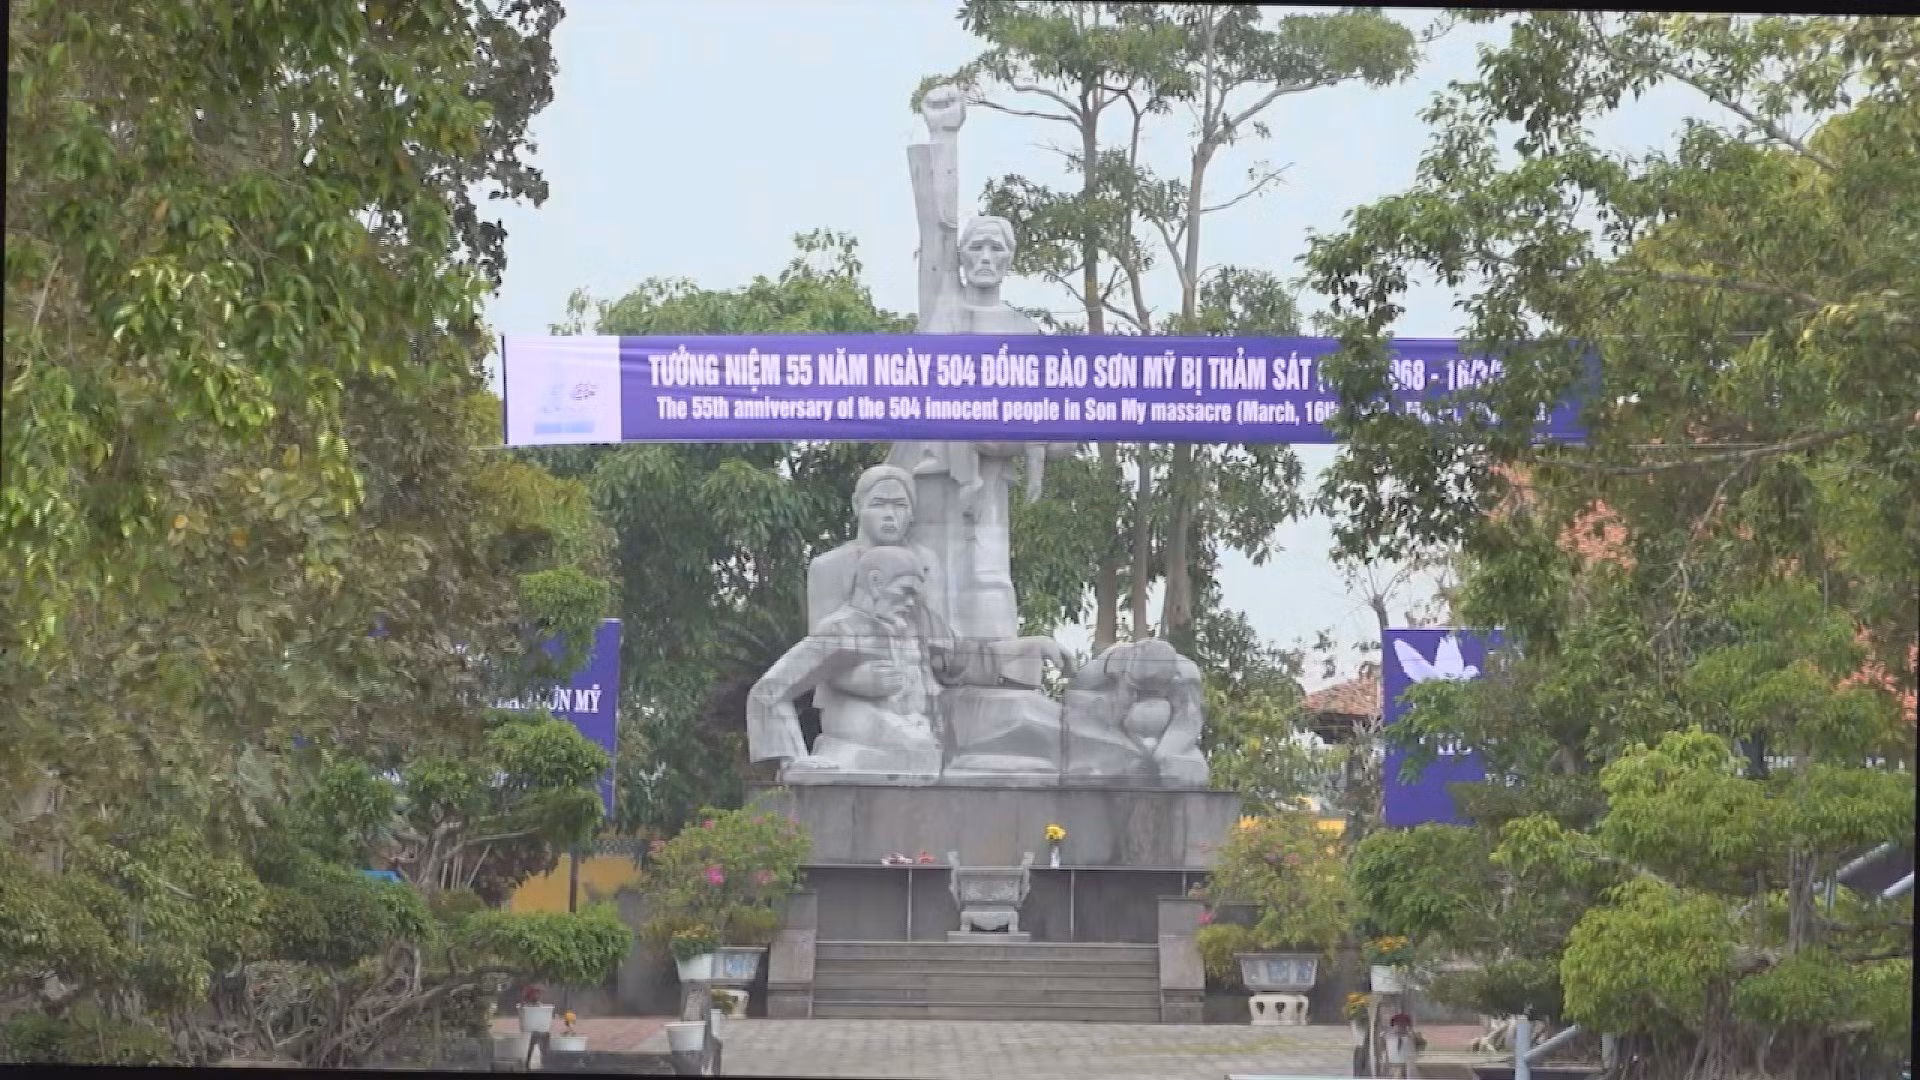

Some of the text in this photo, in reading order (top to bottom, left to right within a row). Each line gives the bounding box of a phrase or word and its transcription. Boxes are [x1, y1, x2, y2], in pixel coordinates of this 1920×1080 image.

[648, 344, 720, 386] TƯỞNG
[725, 348, 781, 393] NIỆM
[786, 354, 814, 385] 55
[818, 348, 868, 386] NĂM
[874, 347, 931, 386] NGÀY
[936, 354, 976, 386] 504
[1045, 348, 1088, 388] BÀO
[1093, 353, 1138, 389] SƠN
[1143, 349, 1176, 389] MỸ
[1181, 355, 1204, 396] BỊ
[1208, 347, 1267, 391] THẢM
[1272, 350, 1312, 391] SÁT
[657, 396, 688, 419] The
[692, 396, 730, 420] 55th
[734, 396, 833, 422] anniversary
[837, 396, 854, 420] of
[857, 396, 886, 420] the
[889, 396, 922, 420] 504
[925, 396, 1000, 420] innocent
[1003, 397, 1060, 424] people
[1064, 397, 1081, 421] in
[1085, 397, 1117, 421] Son
[1121, 397, 1147, 425] My
[1151, 401, 1232, 423] massacre
[1236, 399, 1301, 425] (March,
[574, 684, 603, 714] MỸ
